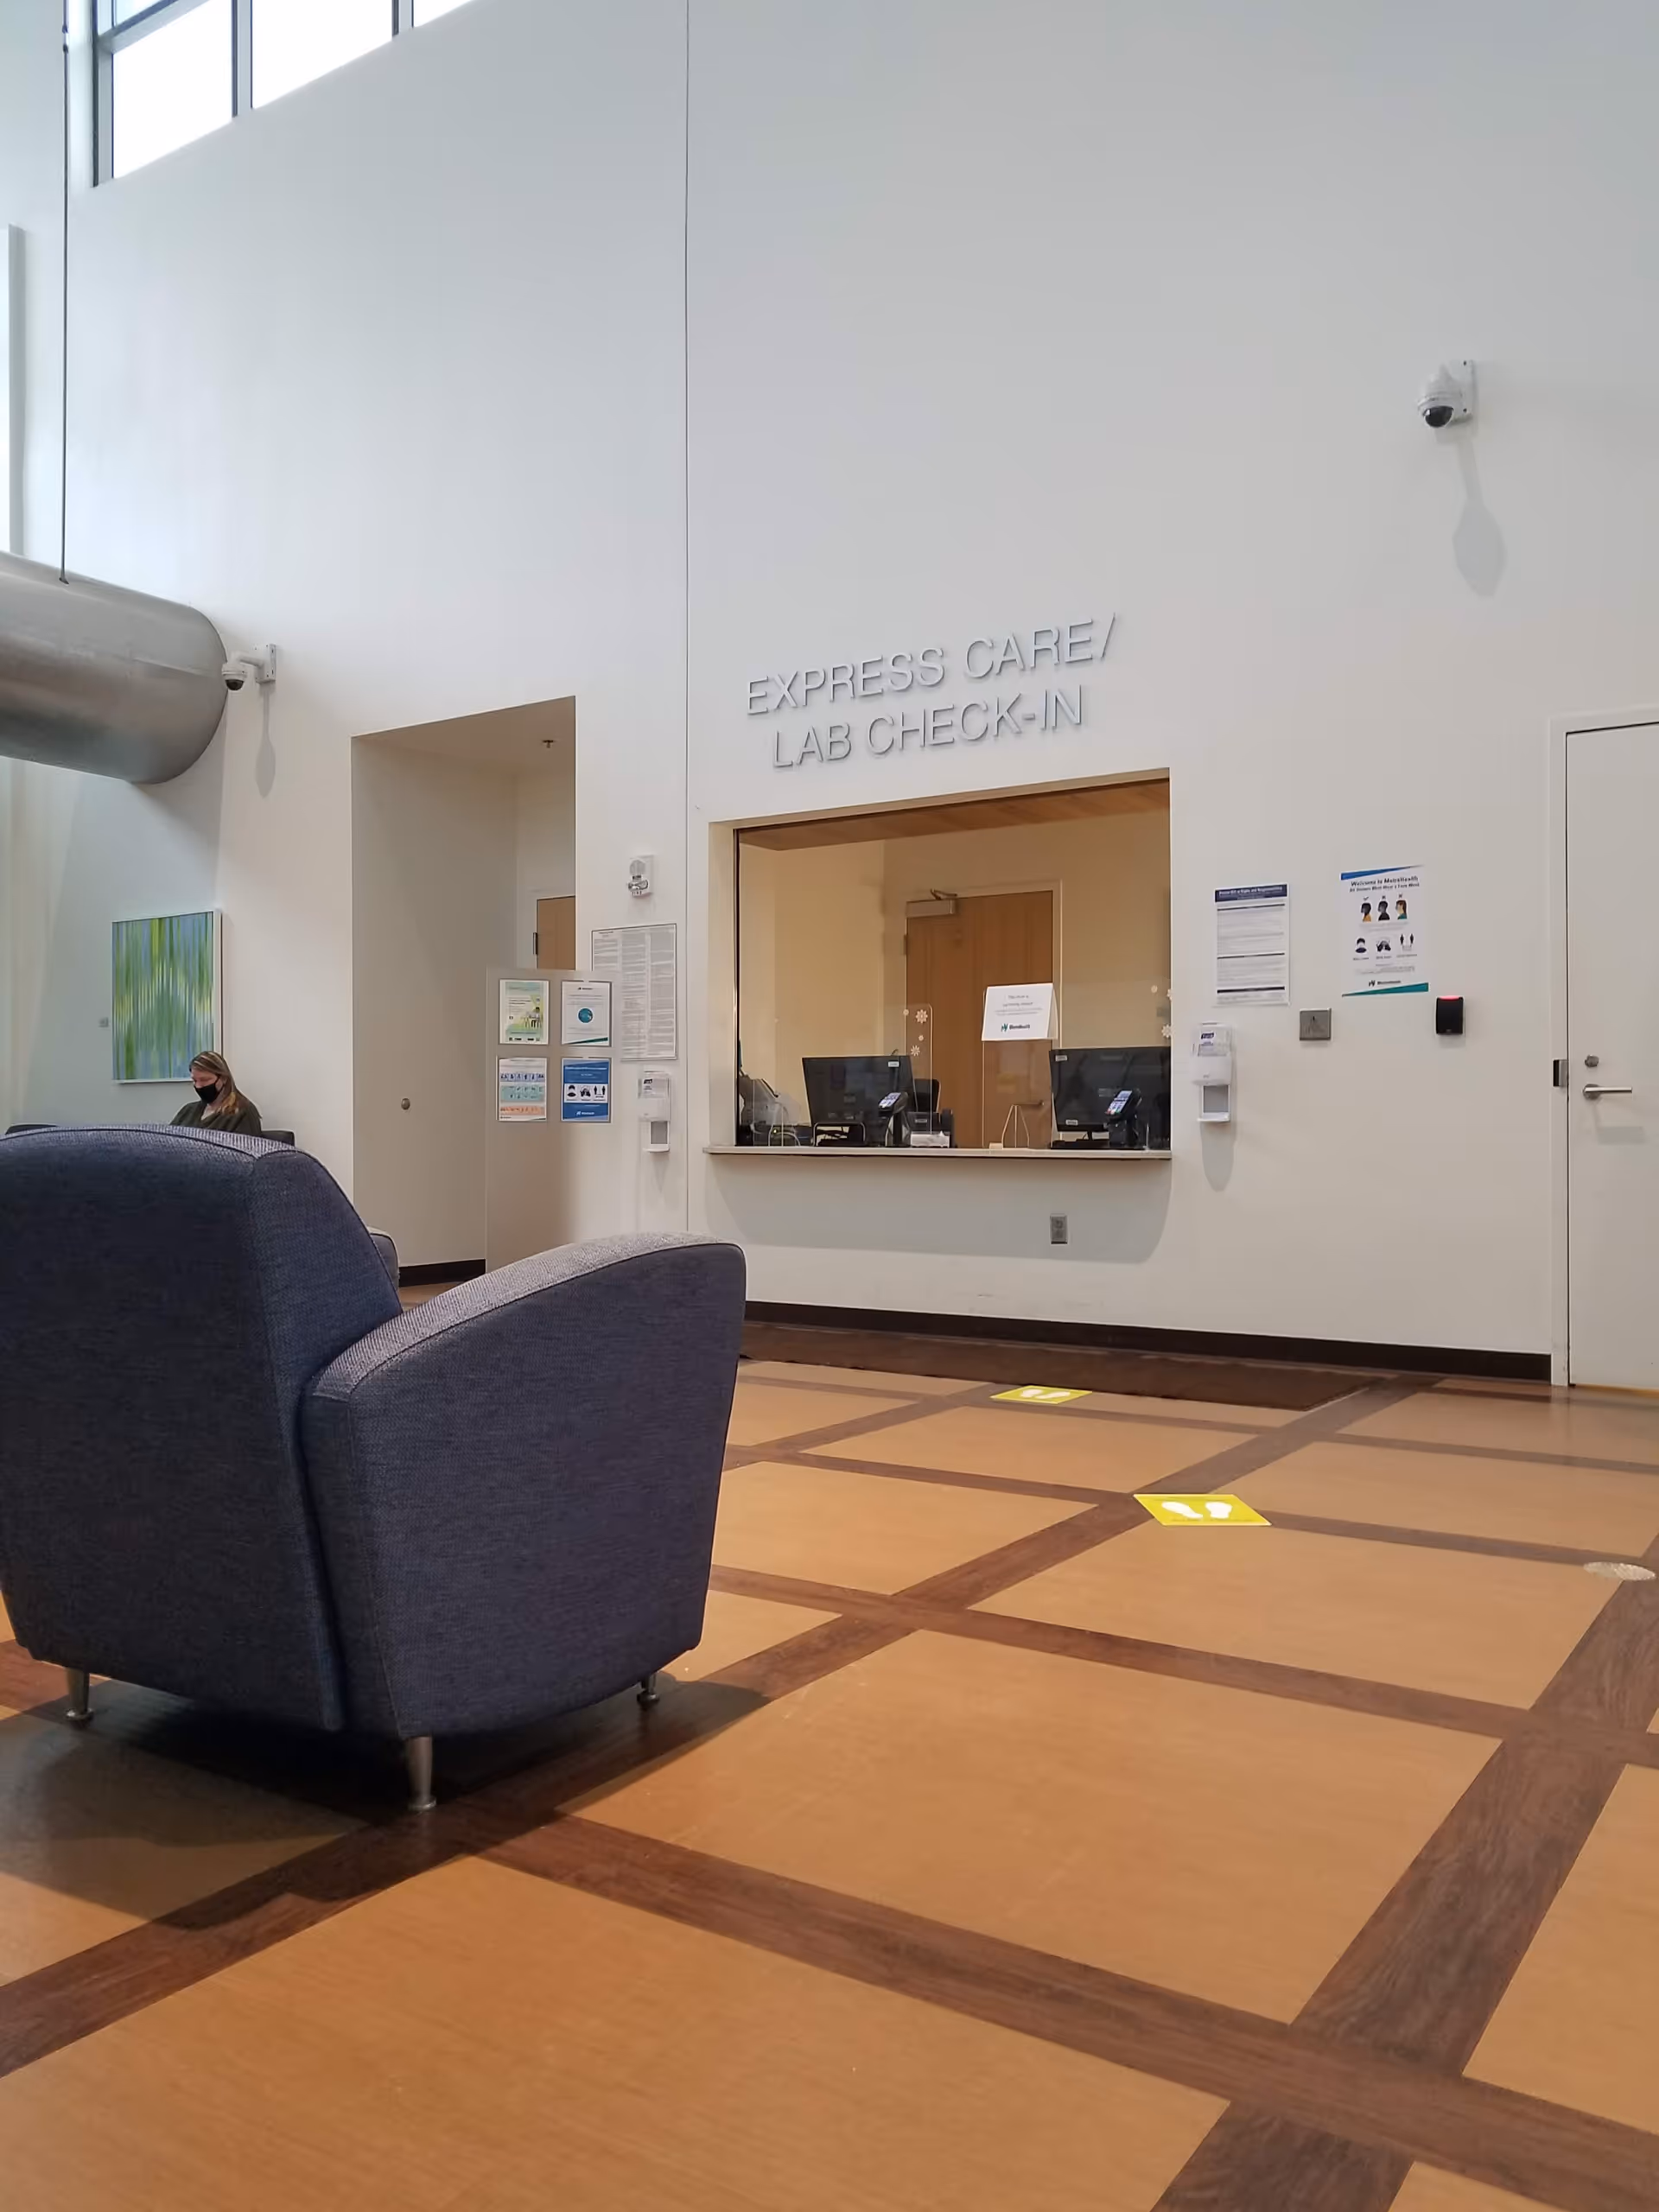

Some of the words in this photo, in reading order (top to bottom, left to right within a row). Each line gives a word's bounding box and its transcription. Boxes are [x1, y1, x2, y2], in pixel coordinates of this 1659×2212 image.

[747, 647, 945, 715] EXPRESS
[964, 612, 1116, 679] CARE/
[772, 722, 853, 769] LAB
[868, 684, 1083, 755] CHECK-IN
